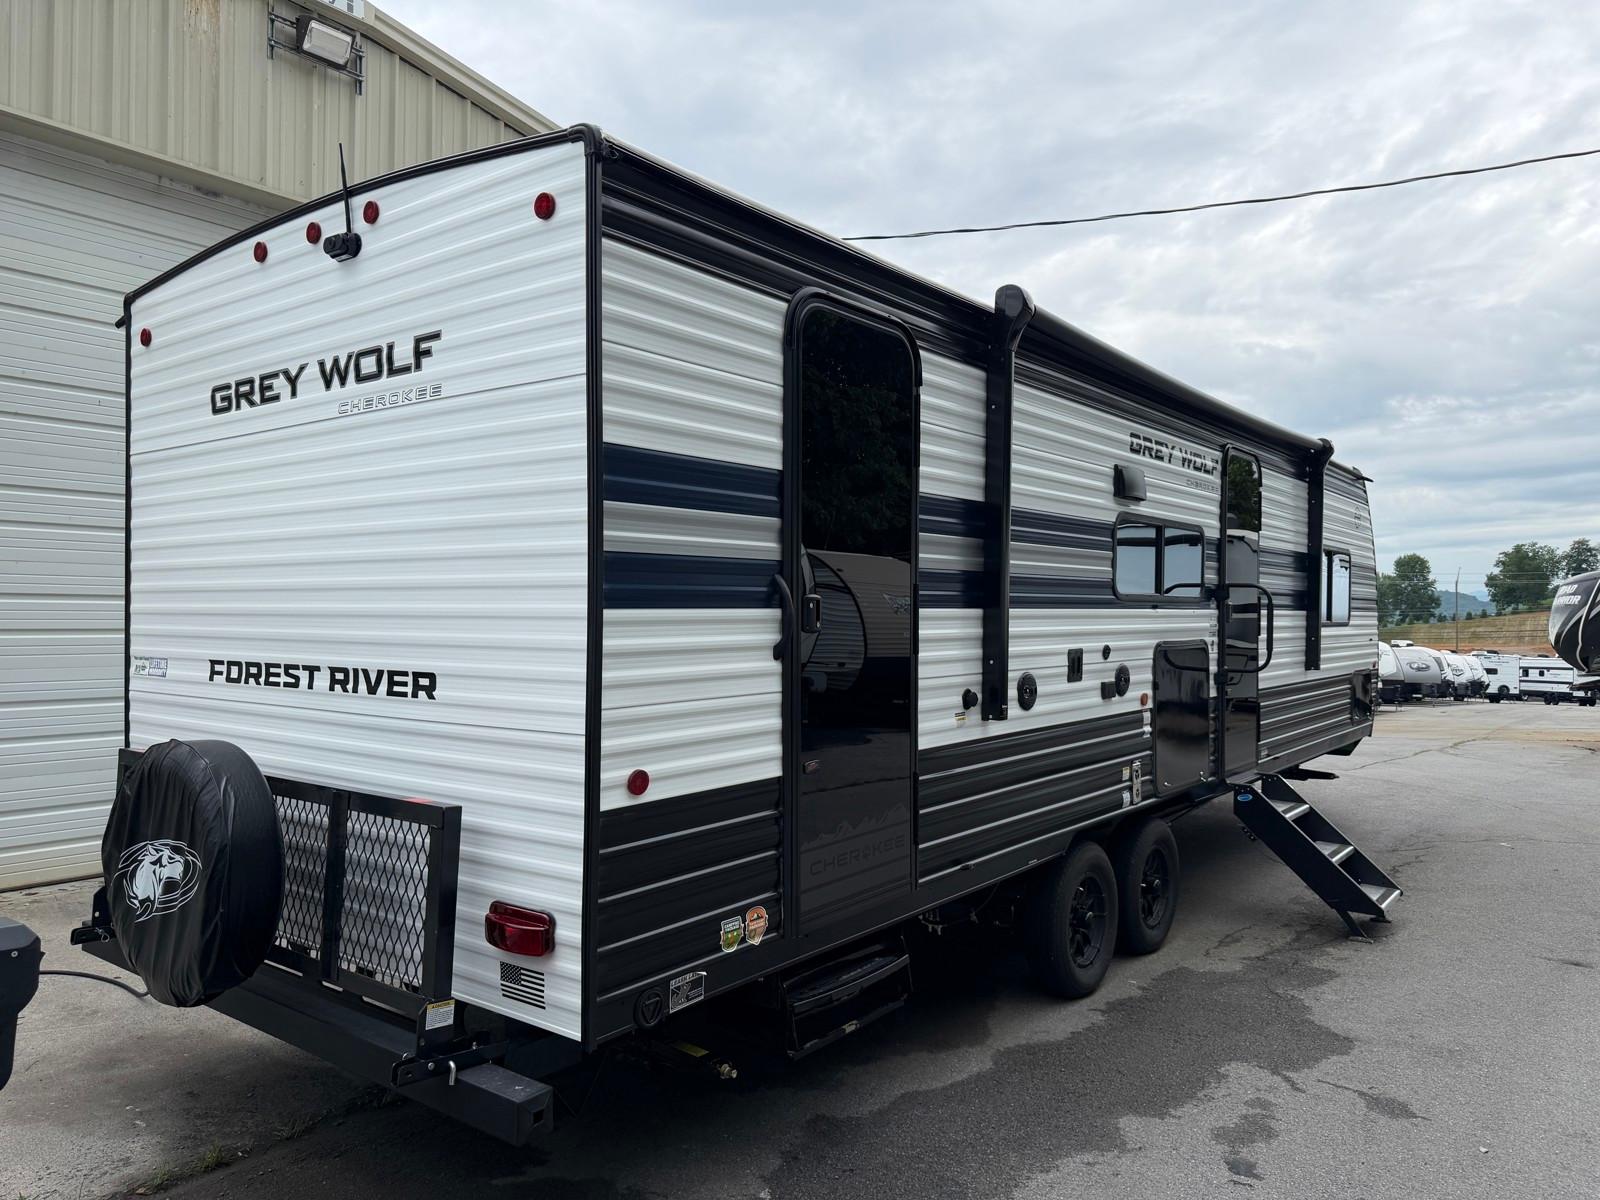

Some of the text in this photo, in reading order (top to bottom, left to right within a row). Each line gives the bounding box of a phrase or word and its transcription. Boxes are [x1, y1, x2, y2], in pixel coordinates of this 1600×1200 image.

[211, 329, 442, 416] GREY WOLF
[338, 383, 442, 414] CHEROKEE
[1129, 432, 1219, 476] GREY WOLF
[208, 659, 437, 700] FOREST RIVER
